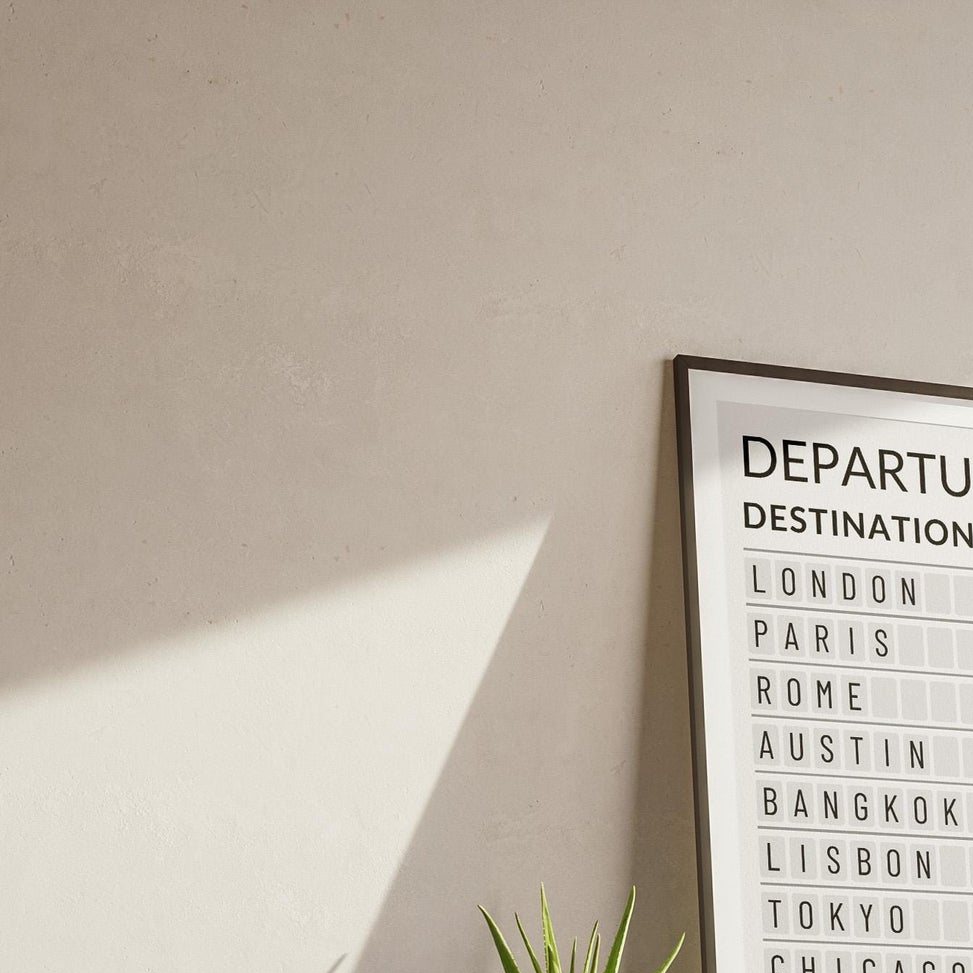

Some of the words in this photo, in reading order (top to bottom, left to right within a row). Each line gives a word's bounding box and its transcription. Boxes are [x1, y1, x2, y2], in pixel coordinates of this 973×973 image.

[743, 501, 973, 549] DESTINATION
[752, 564, 916, 606] LONDON
[754, 619, 888, 657] PARIS
[757, 675, 862, 711] ROME
[759, 730, 924, 769] AUSTIN
[763, 787, 958, 827] BANGKOK
[767, 842, 931, 879] LISBON
[767, 899, 904, 934] TOKYO
